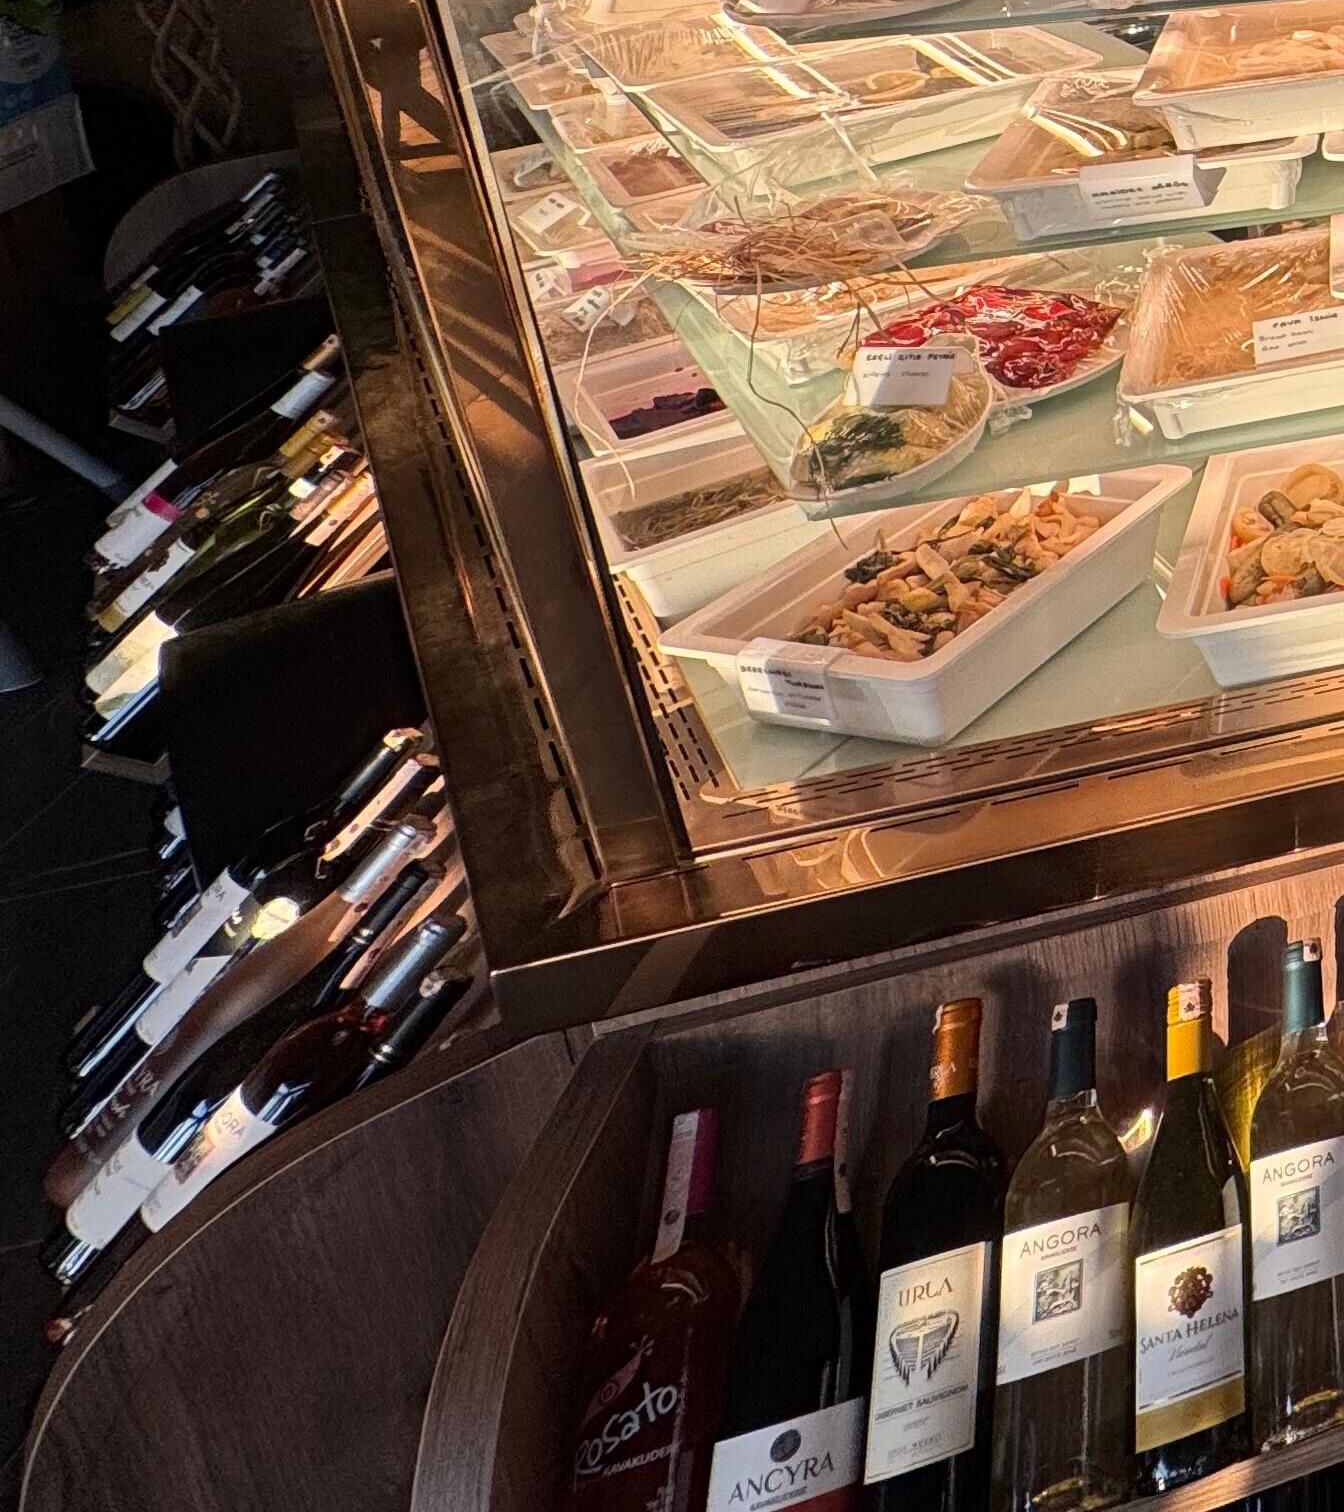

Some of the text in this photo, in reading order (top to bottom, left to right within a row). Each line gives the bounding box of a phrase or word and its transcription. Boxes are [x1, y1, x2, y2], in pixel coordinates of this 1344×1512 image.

[1262, 1151, 1336, 1185] ANGORA
[1019, 1222, 1101, 1260] ANGORA
[898, 1276, 954, 1308] URLA
[1139, 1307, 1240, 1355] SANTA HELENA
[728, 1451, 836, 1506] ANCYRA
